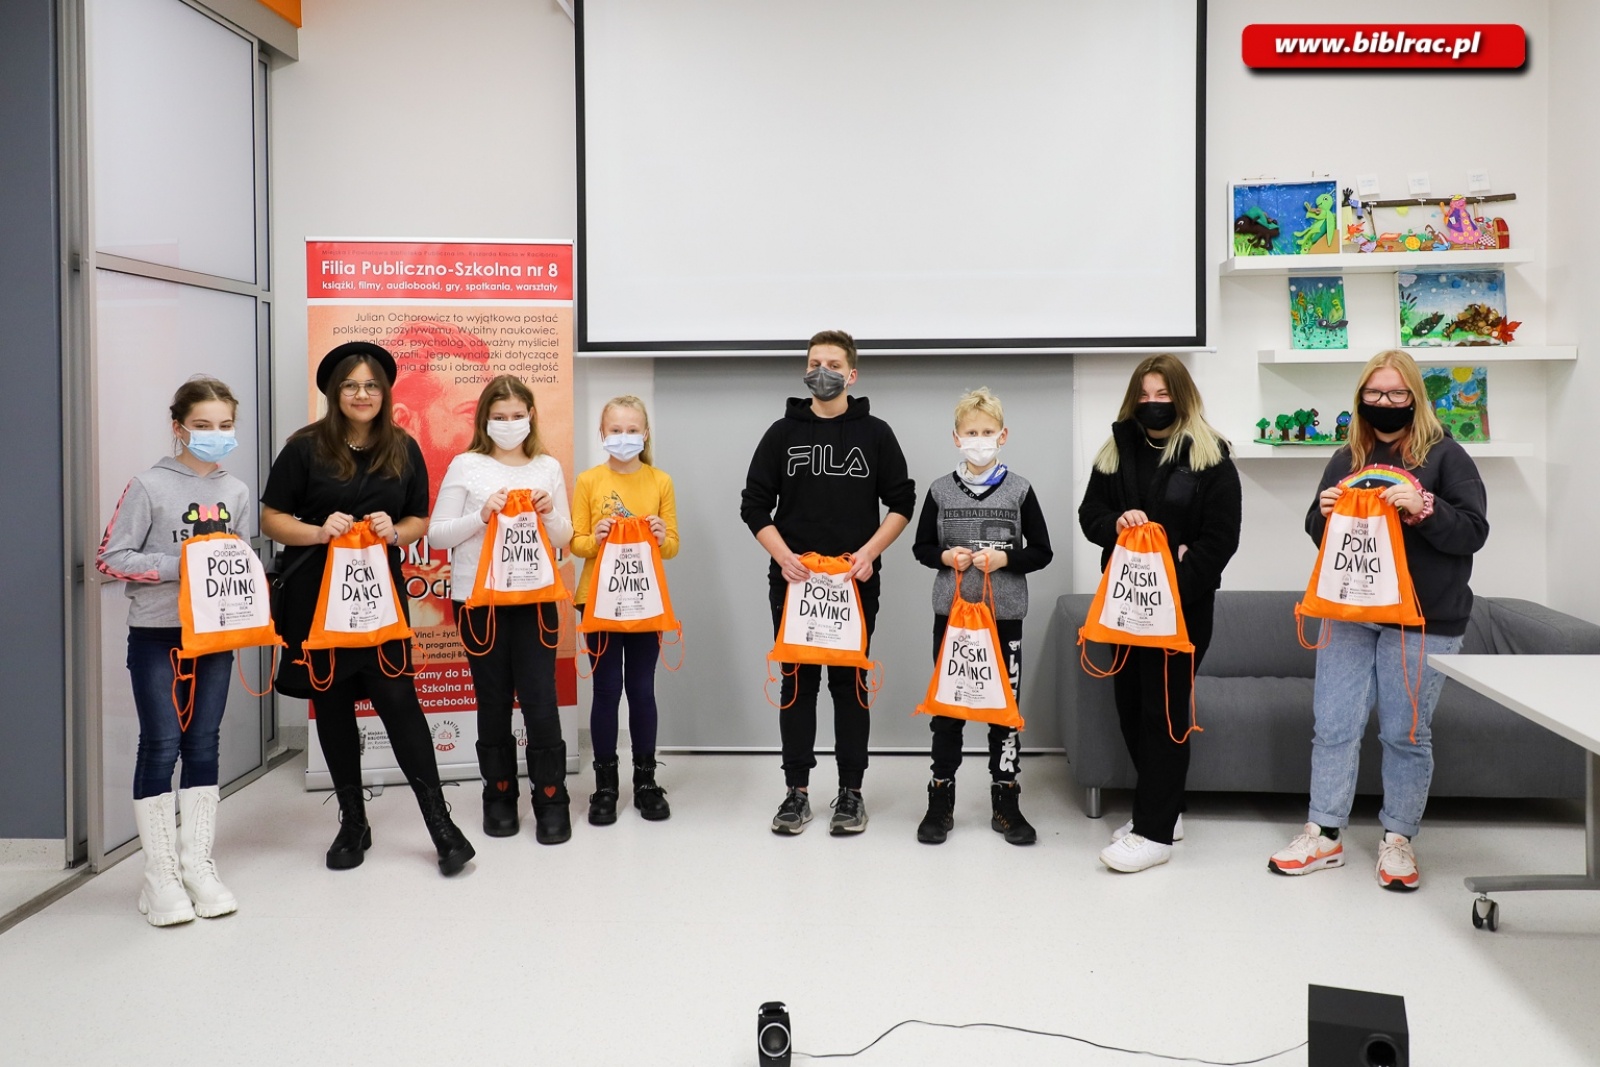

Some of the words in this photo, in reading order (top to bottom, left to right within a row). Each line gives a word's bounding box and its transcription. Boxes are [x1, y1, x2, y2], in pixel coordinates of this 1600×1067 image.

[321, 260, 355, 275] Filia
[362, 260, 522, 277] Publiczno-Szkolna
[527, 265, 543, 277] nr
[548, 263, 558, 277] 8
[322, 281, 356, 291] książki,
[358, 281, 384, 291] filmy,
[386, 281, 443, 291] audiobooki,
[445, 283, 463, 293] gry,
[465, 282, 513, 292] spotkania,
[515, 283, 558, 293] warsztaty
[355, 313, 385, 322] Julian
[388, 313, 450, 322] Ochorowicz
[453, 314, 463, 322] to
[466, 313, 521, 324] wyjątkowa
[523, 313, 559, 324] postać
[333, 325, 383, 336] polskiego
[457, 325, 498, 336] Wybitny
[469, 338, 515, 348] odważny
[518, 337, 559, 348] myśliciel
[425, 350, 451, 361] Jego
[453, 350, 502, 361] wynalazki
[504, 350, 559, 361] dotyczące
[419, 362, 447, 373] głosu
[455, 362, 490, 371] obrazu
[509, 362, 559, 373] odległość
[531, 374, 559, 383] świat.
[787, 444, 869, 478] FILA
[961, 509, 1017, 520] TRADEMARK
[804, 582, 849, 603] POLSKI
[445, 669, 459, 678] do
